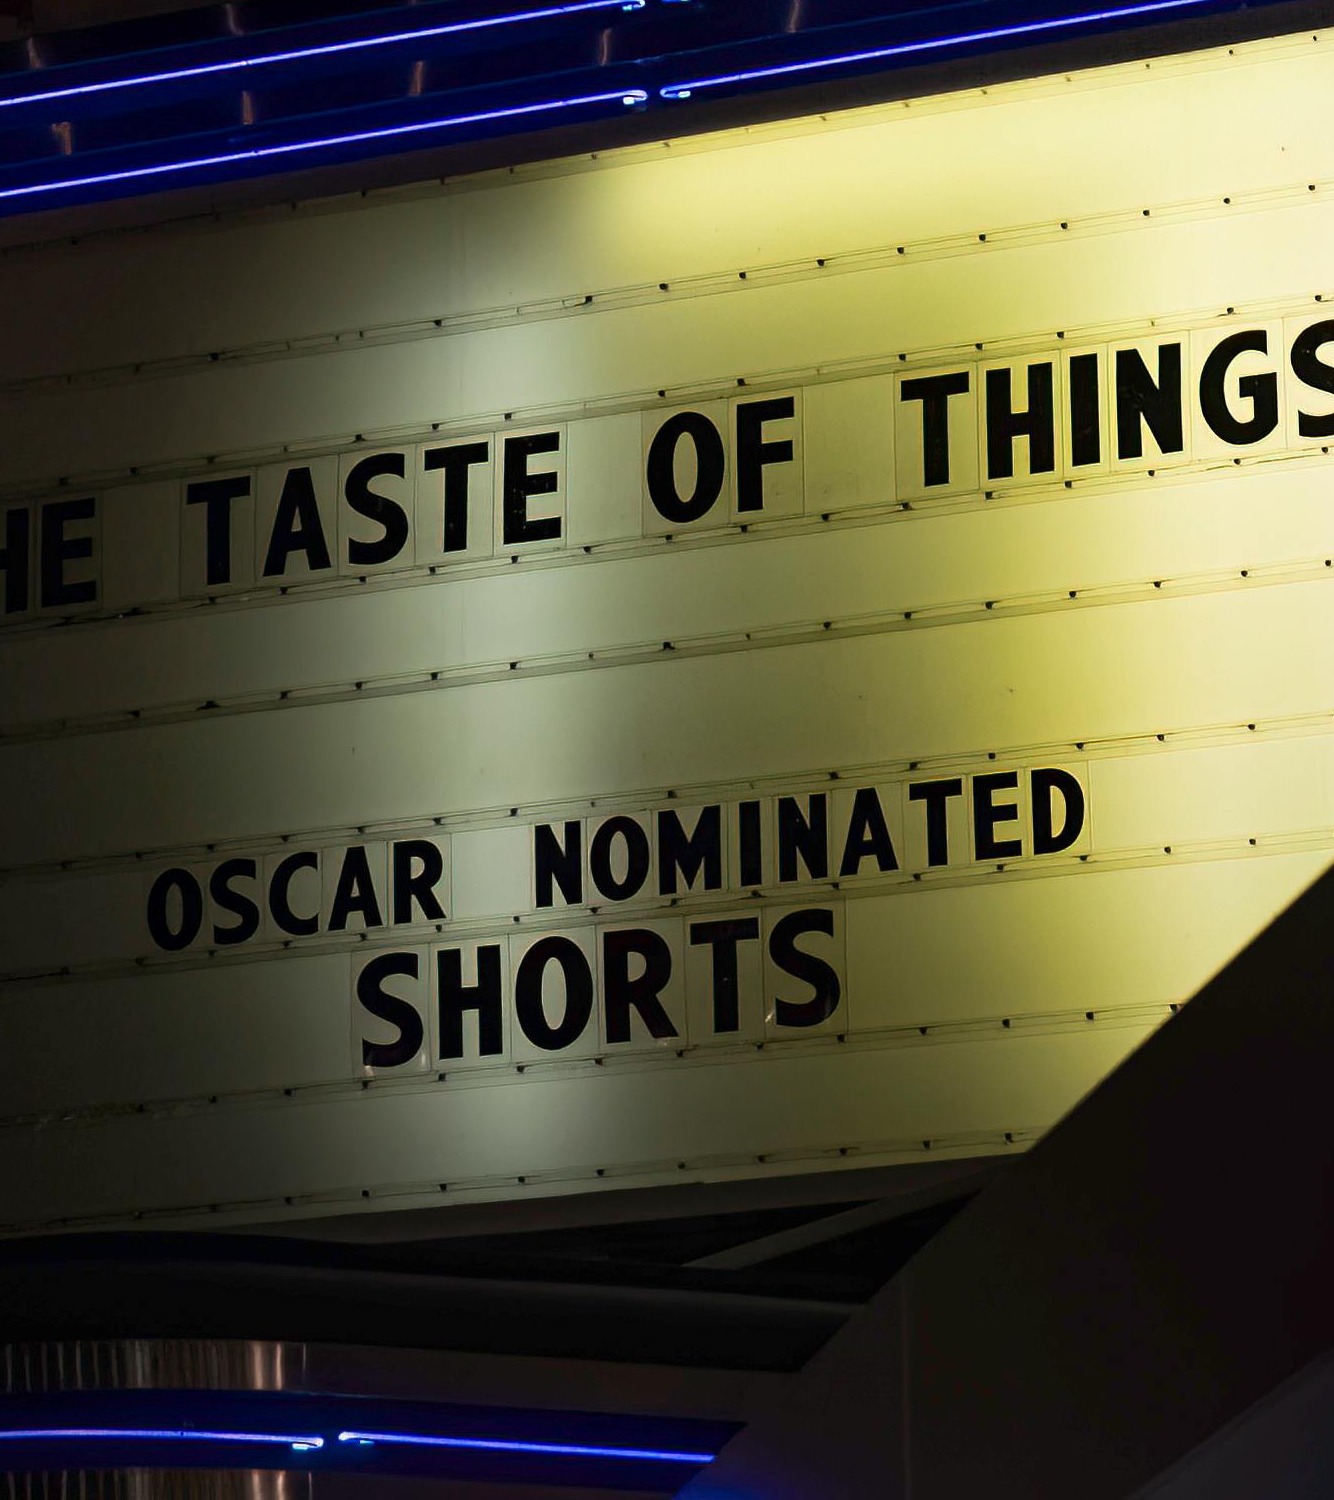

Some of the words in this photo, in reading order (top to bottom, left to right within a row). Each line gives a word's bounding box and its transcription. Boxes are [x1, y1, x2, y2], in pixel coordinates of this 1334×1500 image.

[185, 430, 563, 586] TASTE
[645, 395, 796, 524] OF
[146, 838, 448, 952] OSCAR
[533, 767, 1087, 909] NOMINATED
[355, 908, 841, 1069] SHORTS
